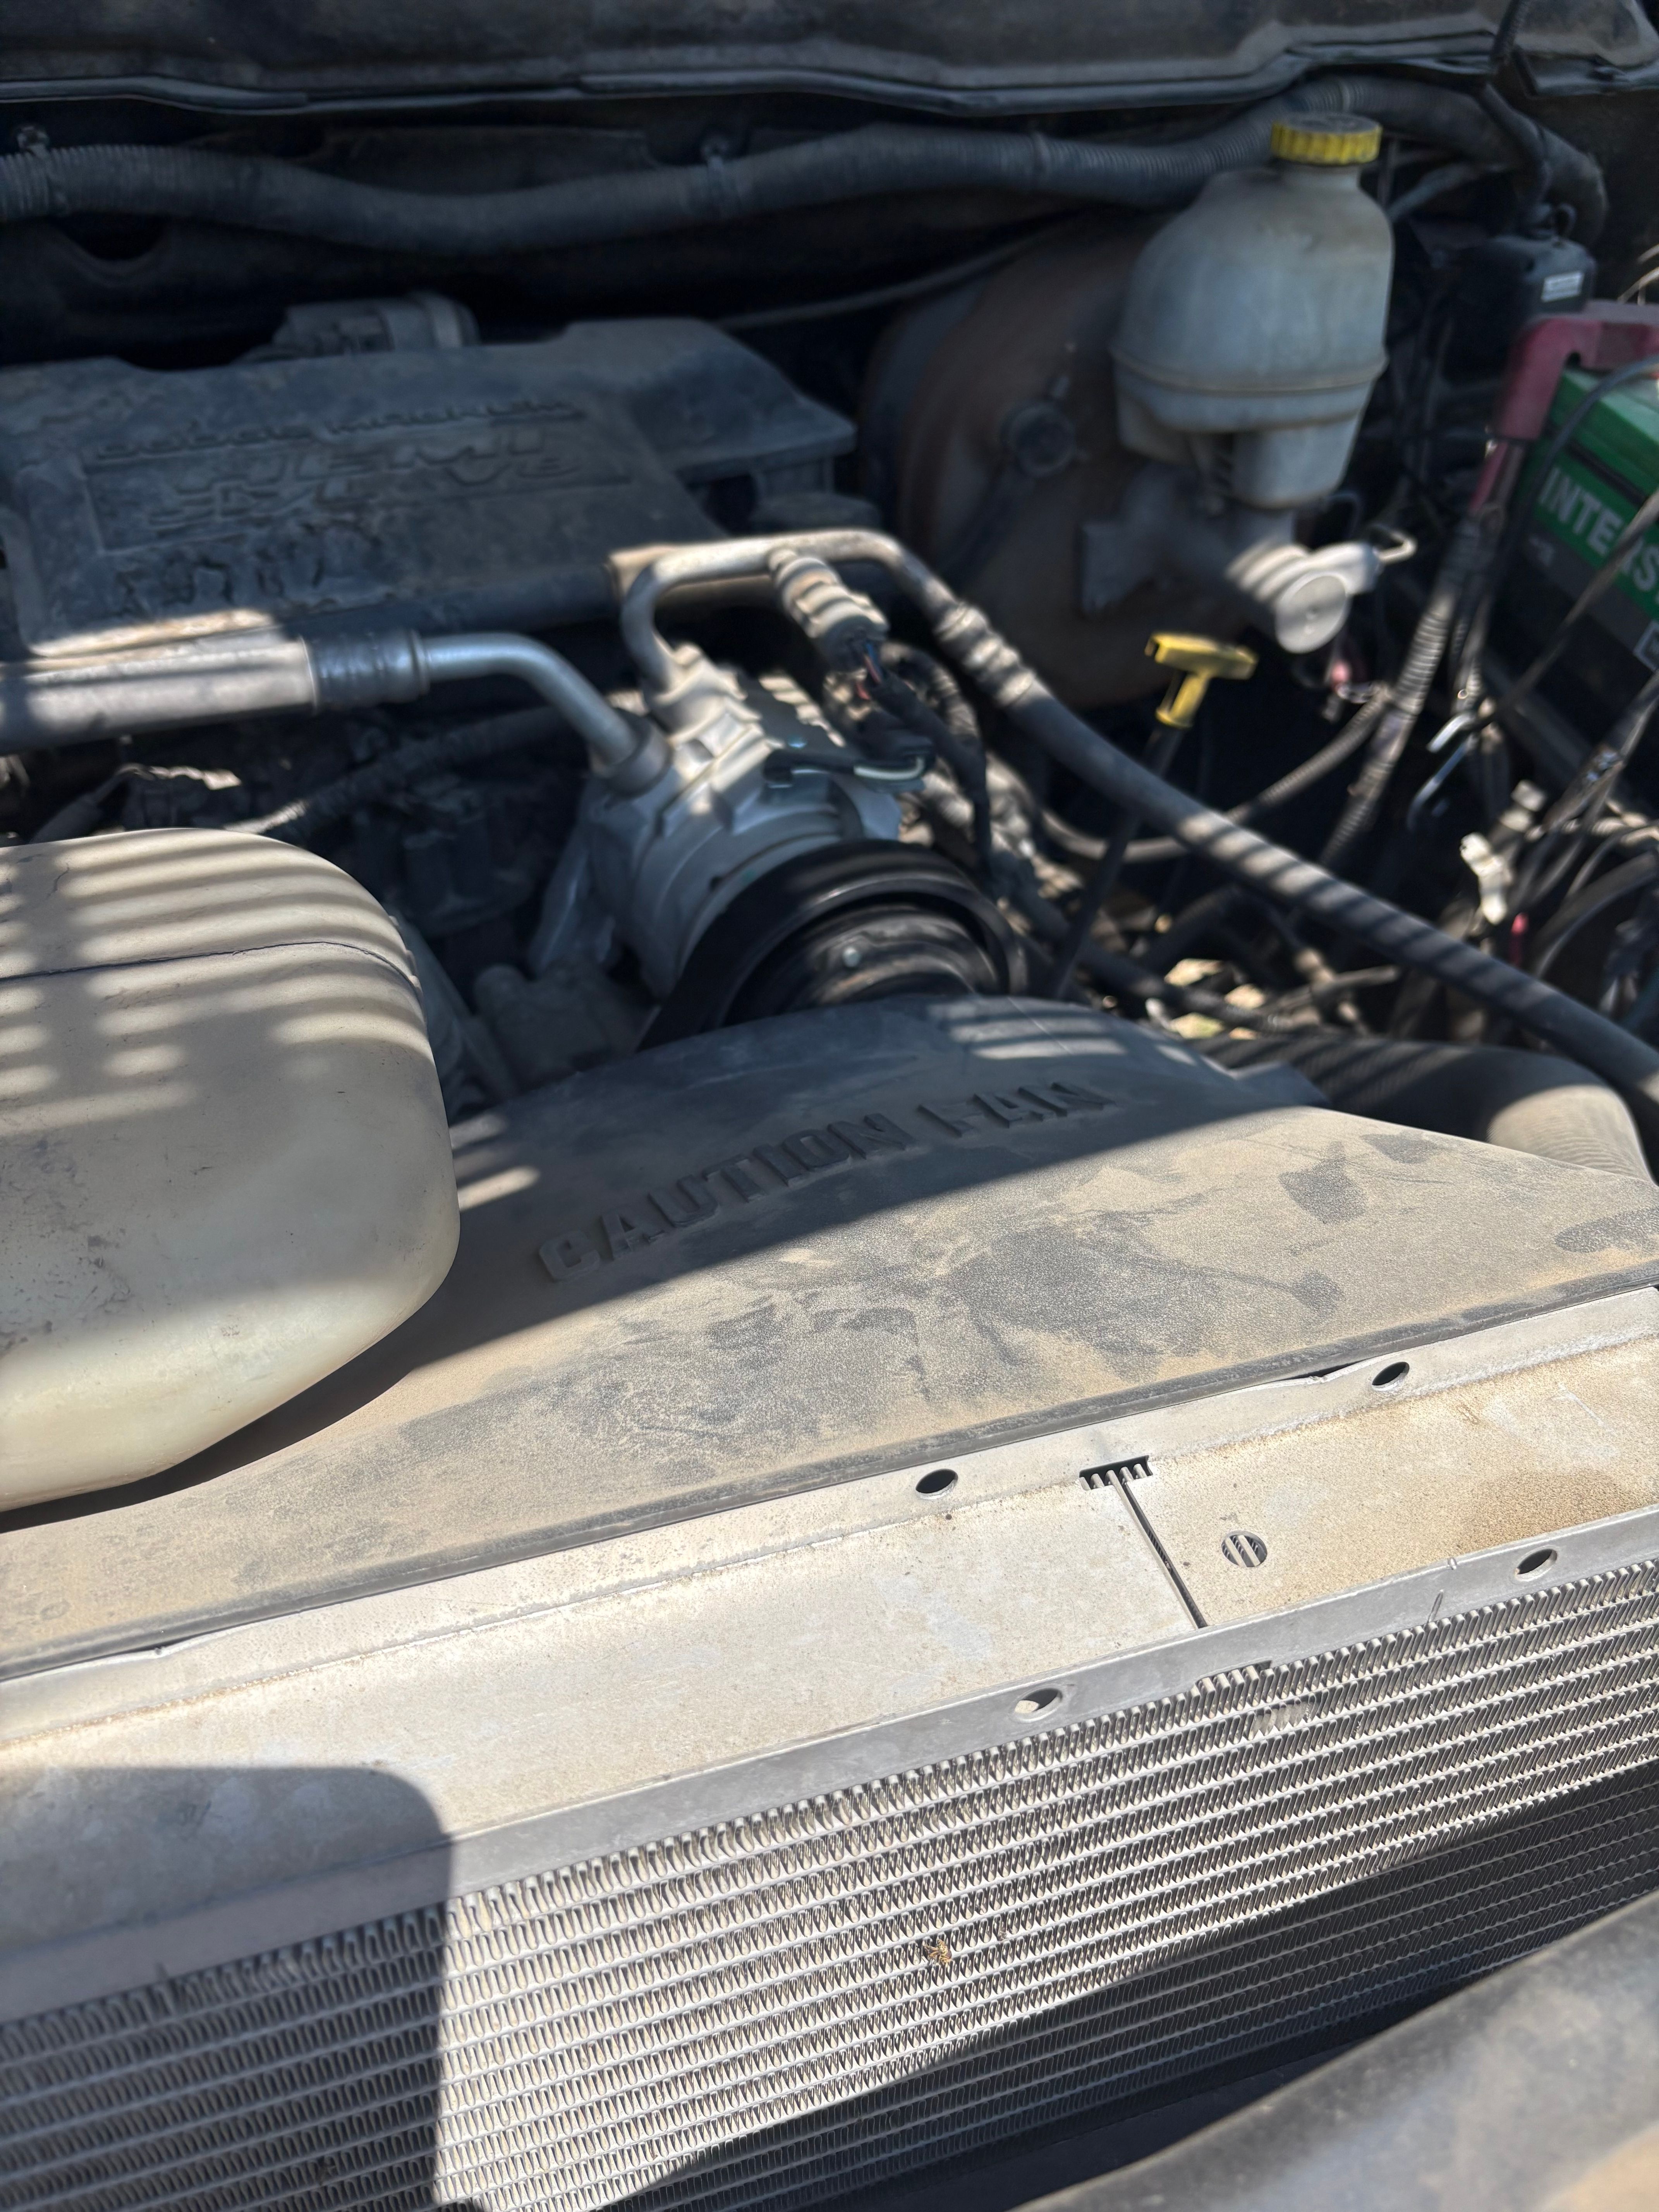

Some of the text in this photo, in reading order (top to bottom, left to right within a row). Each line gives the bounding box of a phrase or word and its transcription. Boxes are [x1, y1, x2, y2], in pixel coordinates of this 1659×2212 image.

[1537, 466, 1659, 607] INTES
[539, 1082, 1116, 1282] CAUTION FAN
